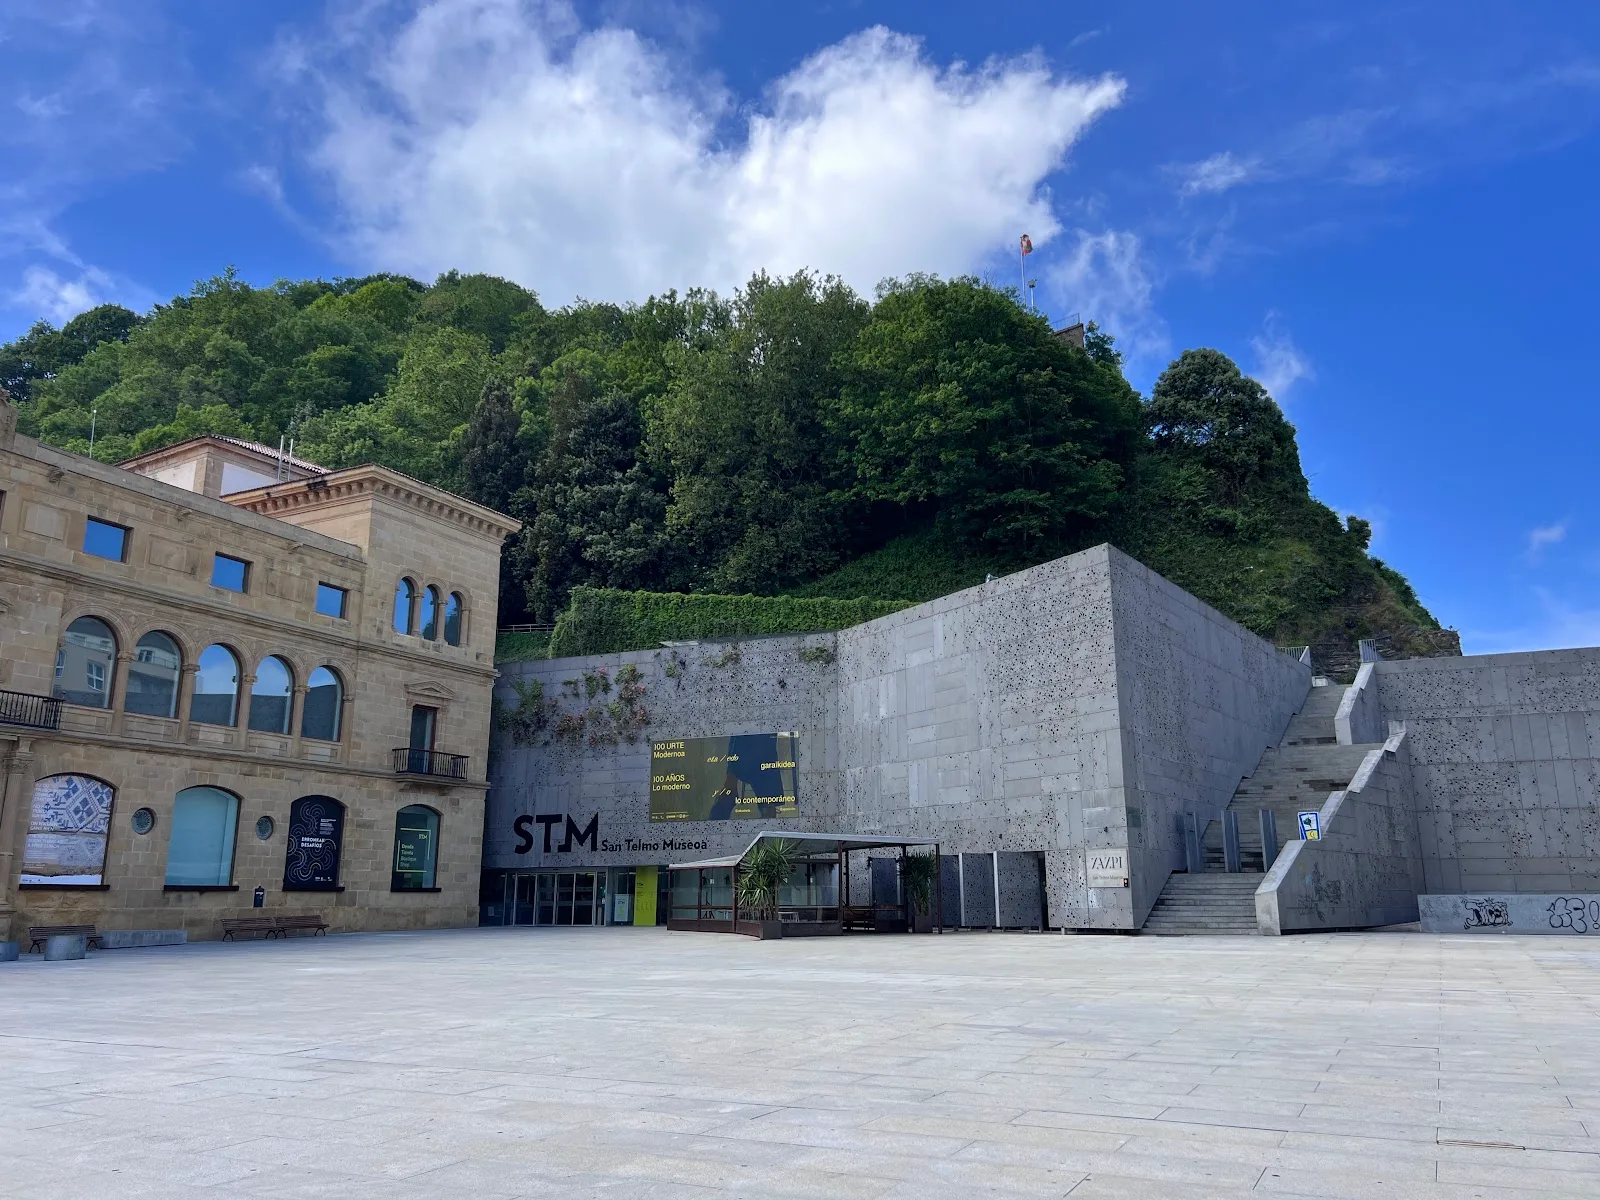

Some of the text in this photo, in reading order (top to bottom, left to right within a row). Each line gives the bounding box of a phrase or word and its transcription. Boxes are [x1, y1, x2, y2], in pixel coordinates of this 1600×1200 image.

[666, 741, 685, 750] URTE
[653, 751, 686, 759] Modernoa
[707, 755, 719, 763] eta
[726, 753, 739, 762] edo
[760, 760, 796, 770] garaikidea
[653, 773, 685, 783] 100 AÑOS
[661, 783, 691, 791] moderno
[735, 794, 796, 804] lo contemporáneo
[513, 811, 600, 855] STM
[601, 837, 708, 852] San Telmo Museoa
[1091, 856, 1123, 869] ZAZPI
